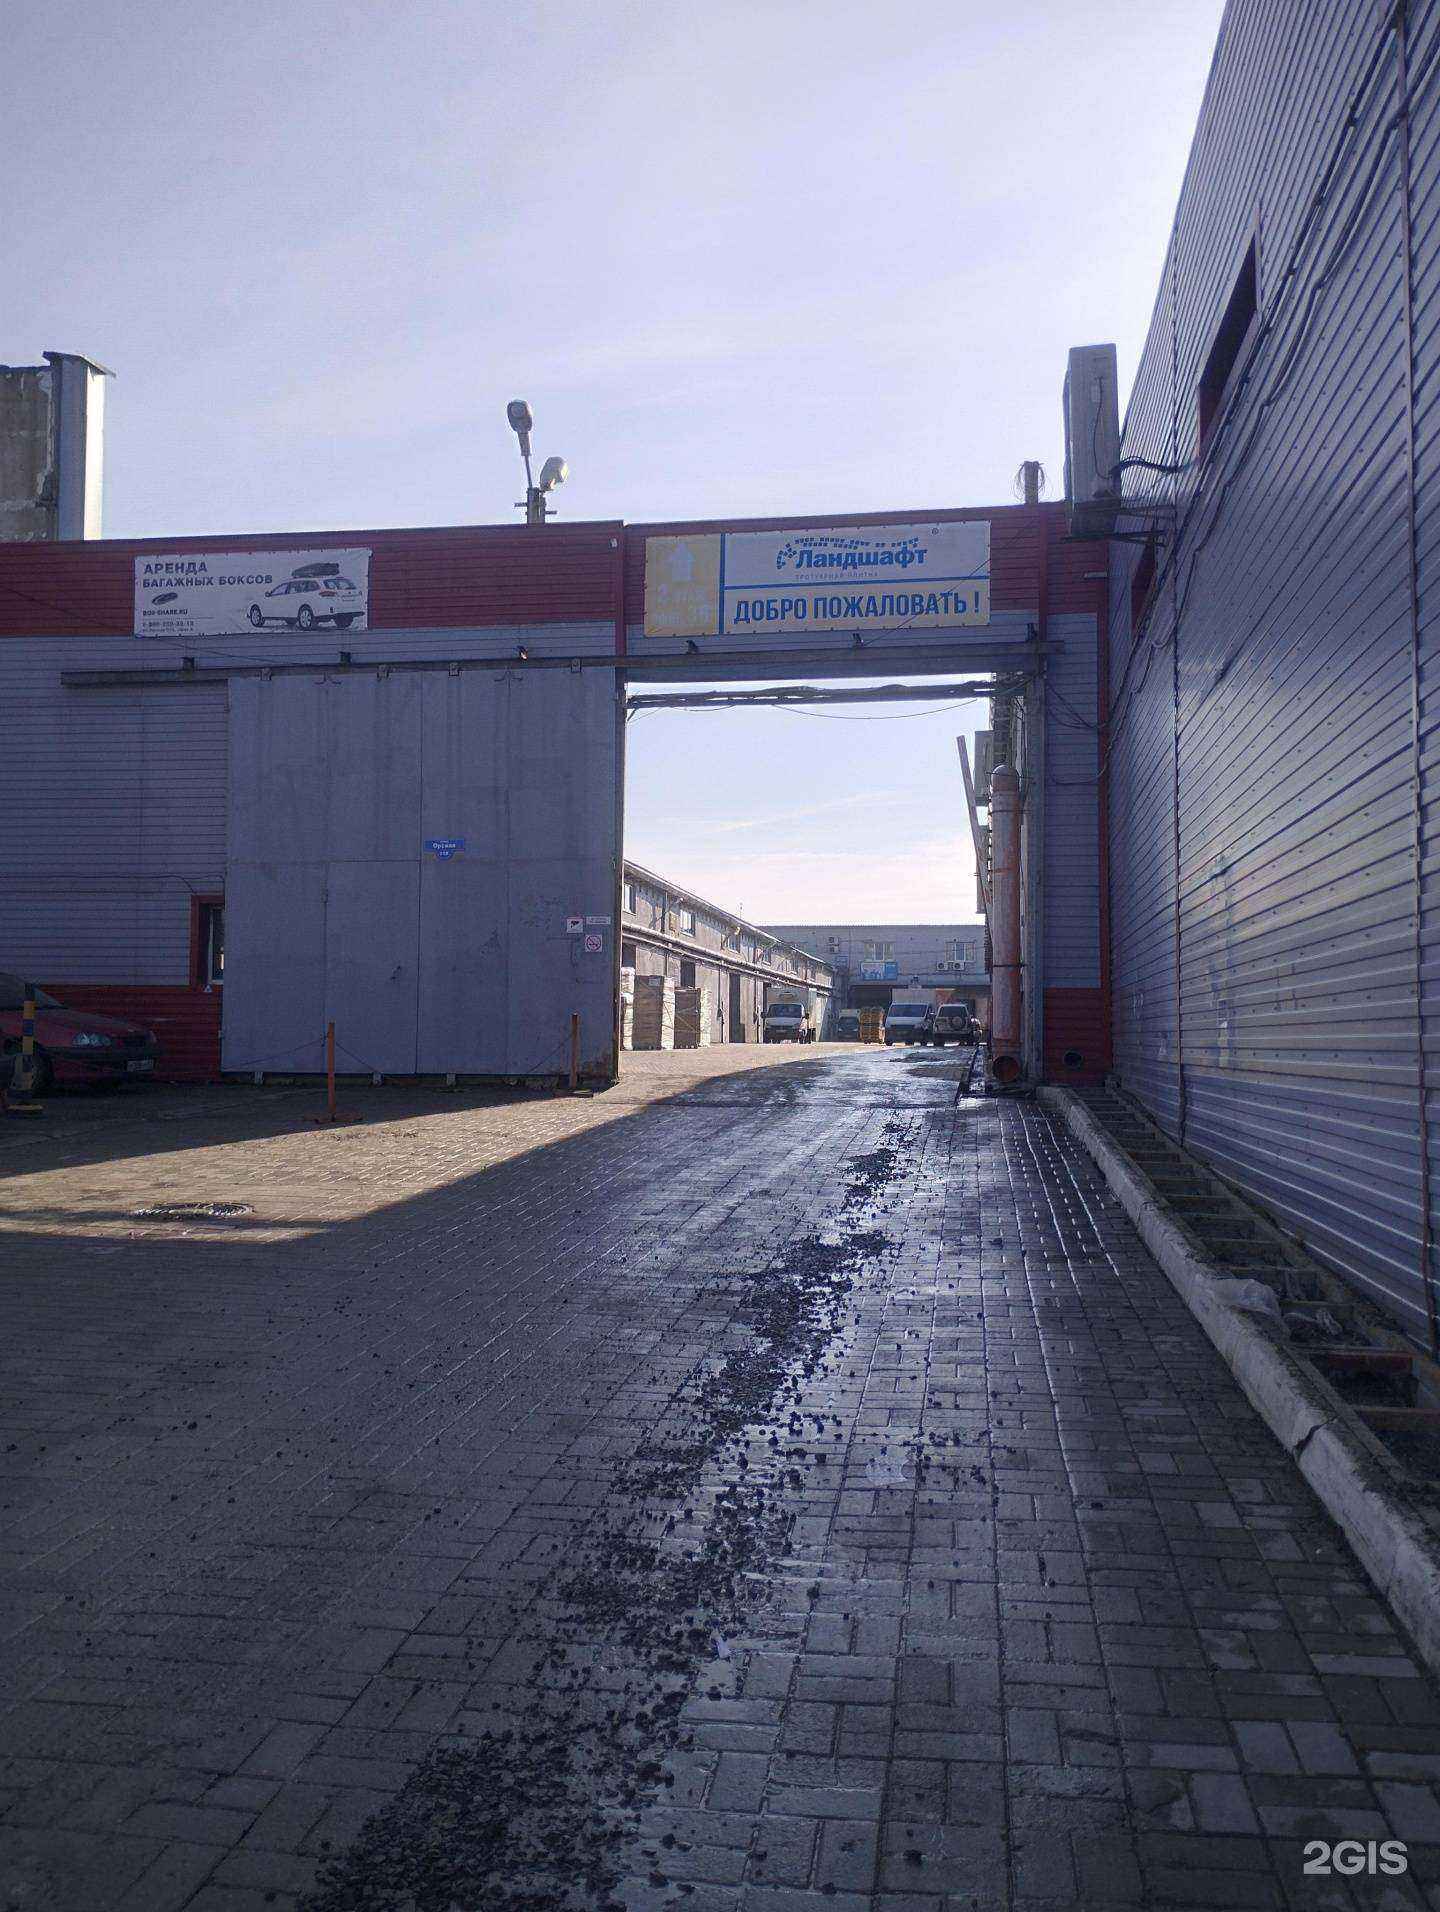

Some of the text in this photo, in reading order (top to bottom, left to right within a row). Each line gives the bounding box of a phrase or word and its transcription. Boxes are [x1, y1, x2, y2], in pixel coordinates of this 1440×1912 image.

[143, 561, 208, 576] АРЕНДА
[795, 546, 928, 571] Ландшафт
[142, 574, 273, 588] БАГАЖНЫХ БОКСОВ
[733, 597, 807, 625] ДОБРО
